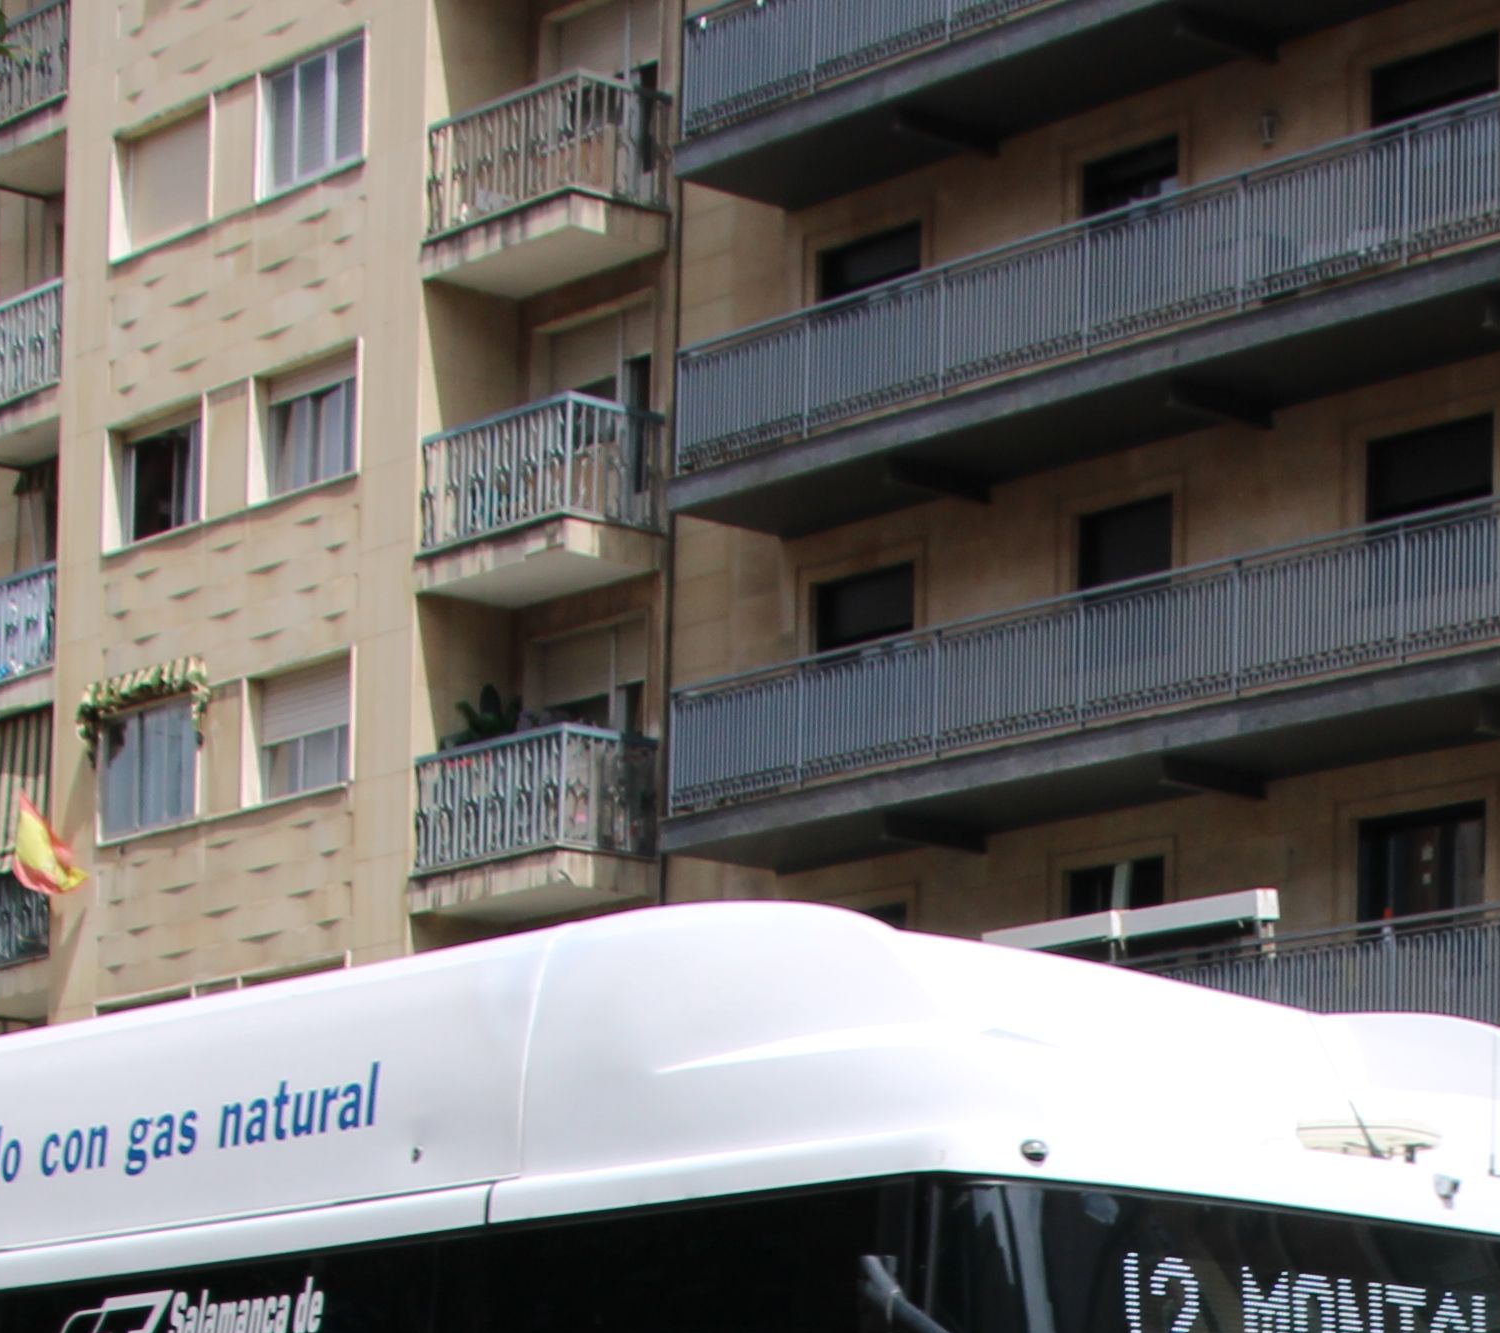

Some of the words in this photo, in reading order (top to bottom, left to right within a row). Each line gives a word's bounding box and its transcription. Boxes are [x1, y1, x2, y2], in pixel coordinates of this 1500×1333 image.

[40, 1123, 108, 1178] con
[123, 1109, 198, 1177] gas
[217, 1060, 382, 1149] natural
